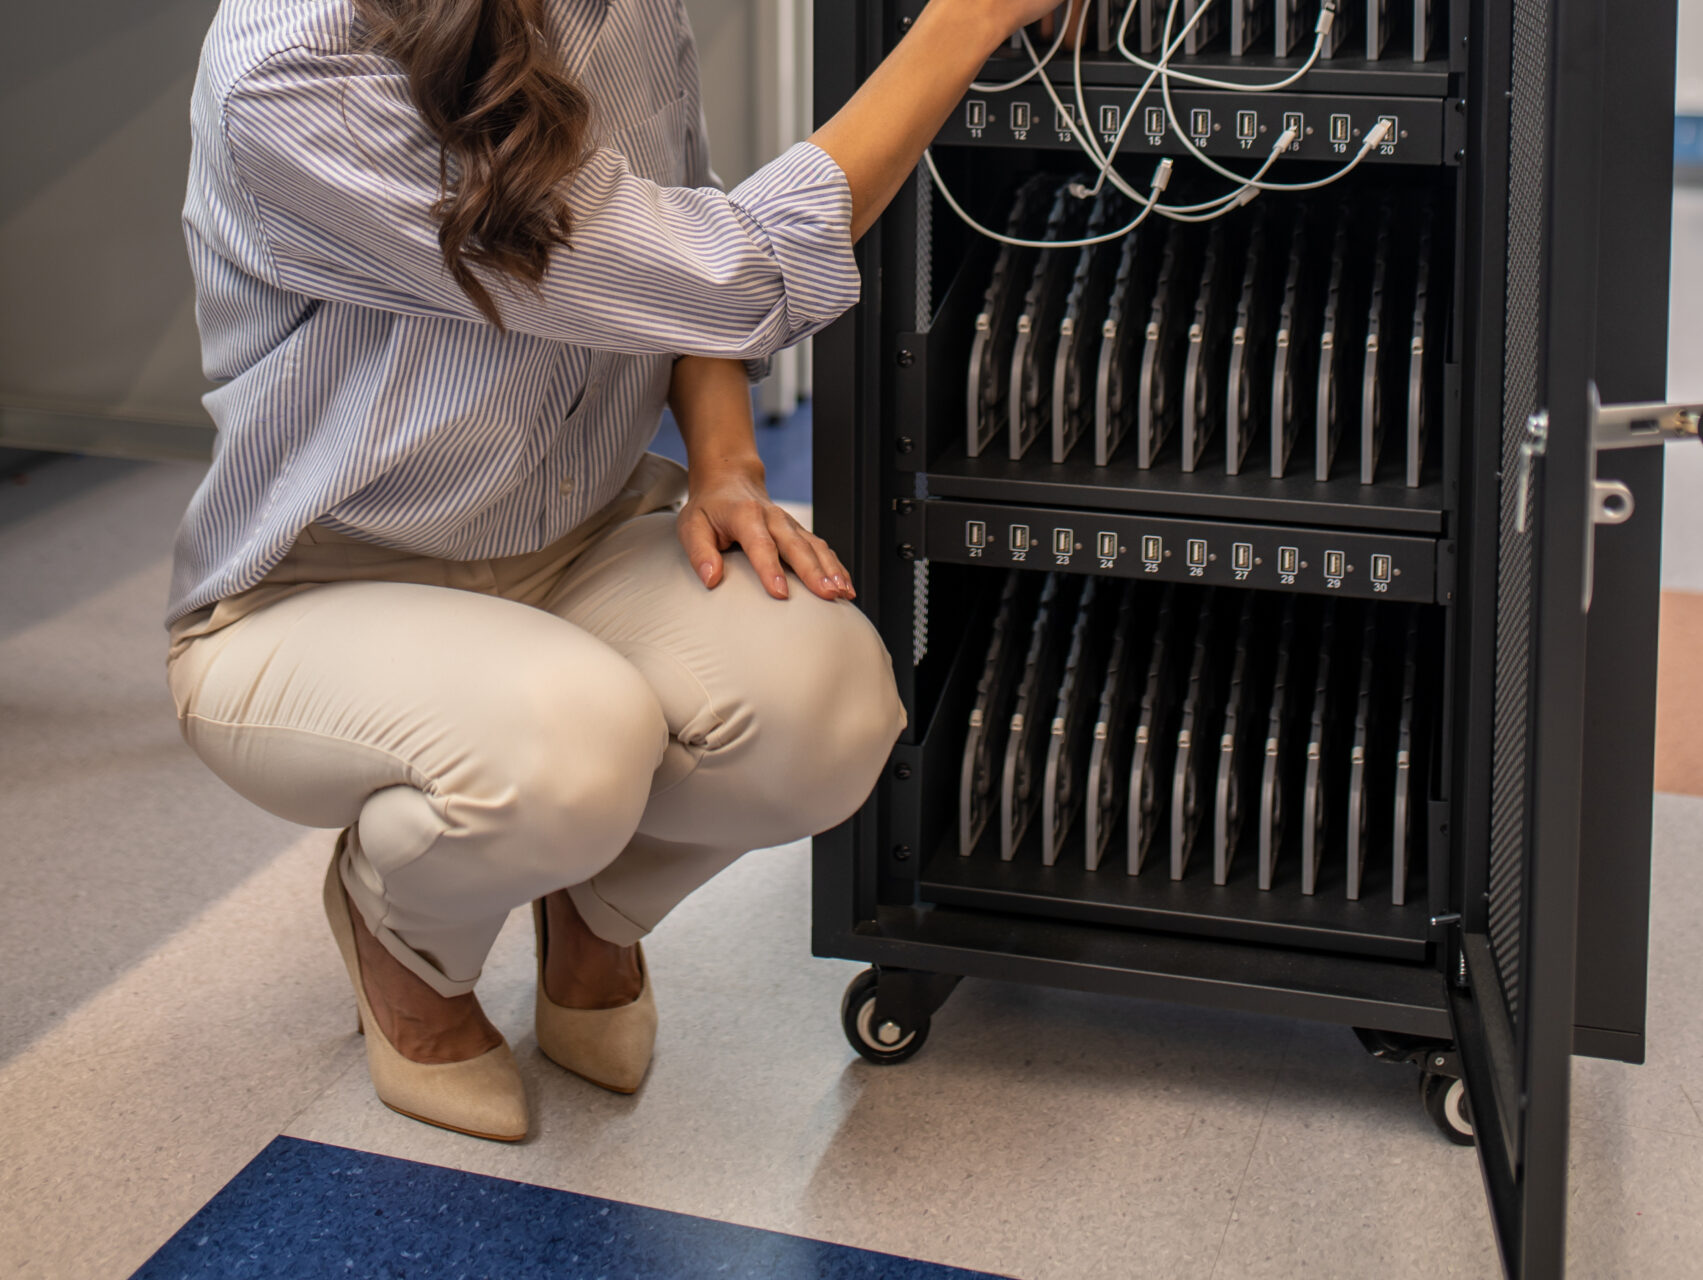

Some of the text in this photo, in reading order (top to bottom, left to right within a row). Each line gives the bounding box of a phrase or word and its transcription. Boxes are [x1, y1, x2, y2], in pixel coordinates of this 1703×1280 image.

[970, 128, 982, 138] 11
[1014, 130, 1027, 140] 12
[1058, 132, 1071, 142] 13
[1103, 134, 1116, 144] 14
[1148, 135, 1161, 145] 15
[1194, 138, 1207, 148] 16
[1240, 139, 1253, 149] 17
[1333, 143, 1346, 153] 19
[1380, 145, 1394, 155] 20
[969, 548, 1387, 592] 21 22 23 24 25 26 27 28 29 30
